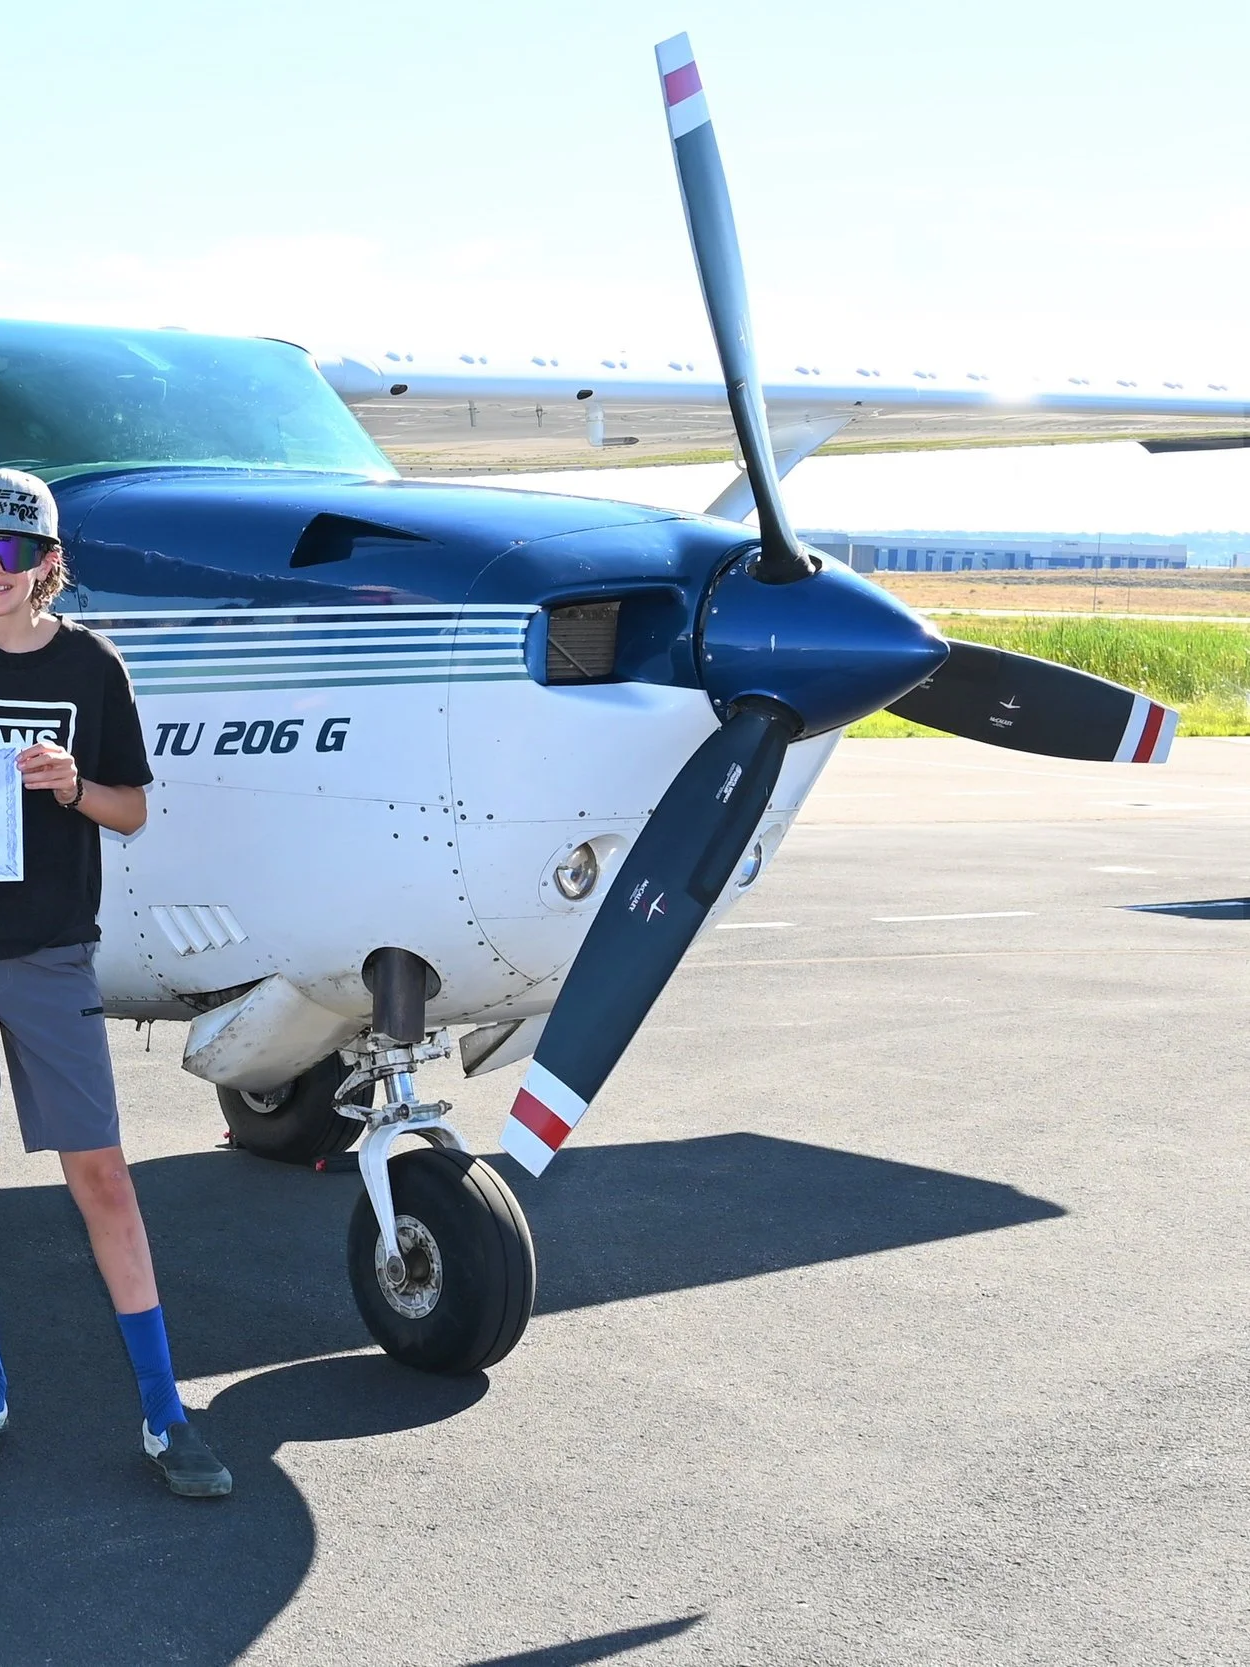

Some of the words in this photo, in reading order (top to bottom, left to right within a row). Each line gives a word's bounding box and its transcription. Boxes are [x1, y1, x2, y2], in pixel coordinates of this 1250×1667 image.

[9, 502, 38, 525] FOX
[153, 722, 206, 756] TU
[213, 718, 305, 756] 206
[315, 717, 351, 753] G
